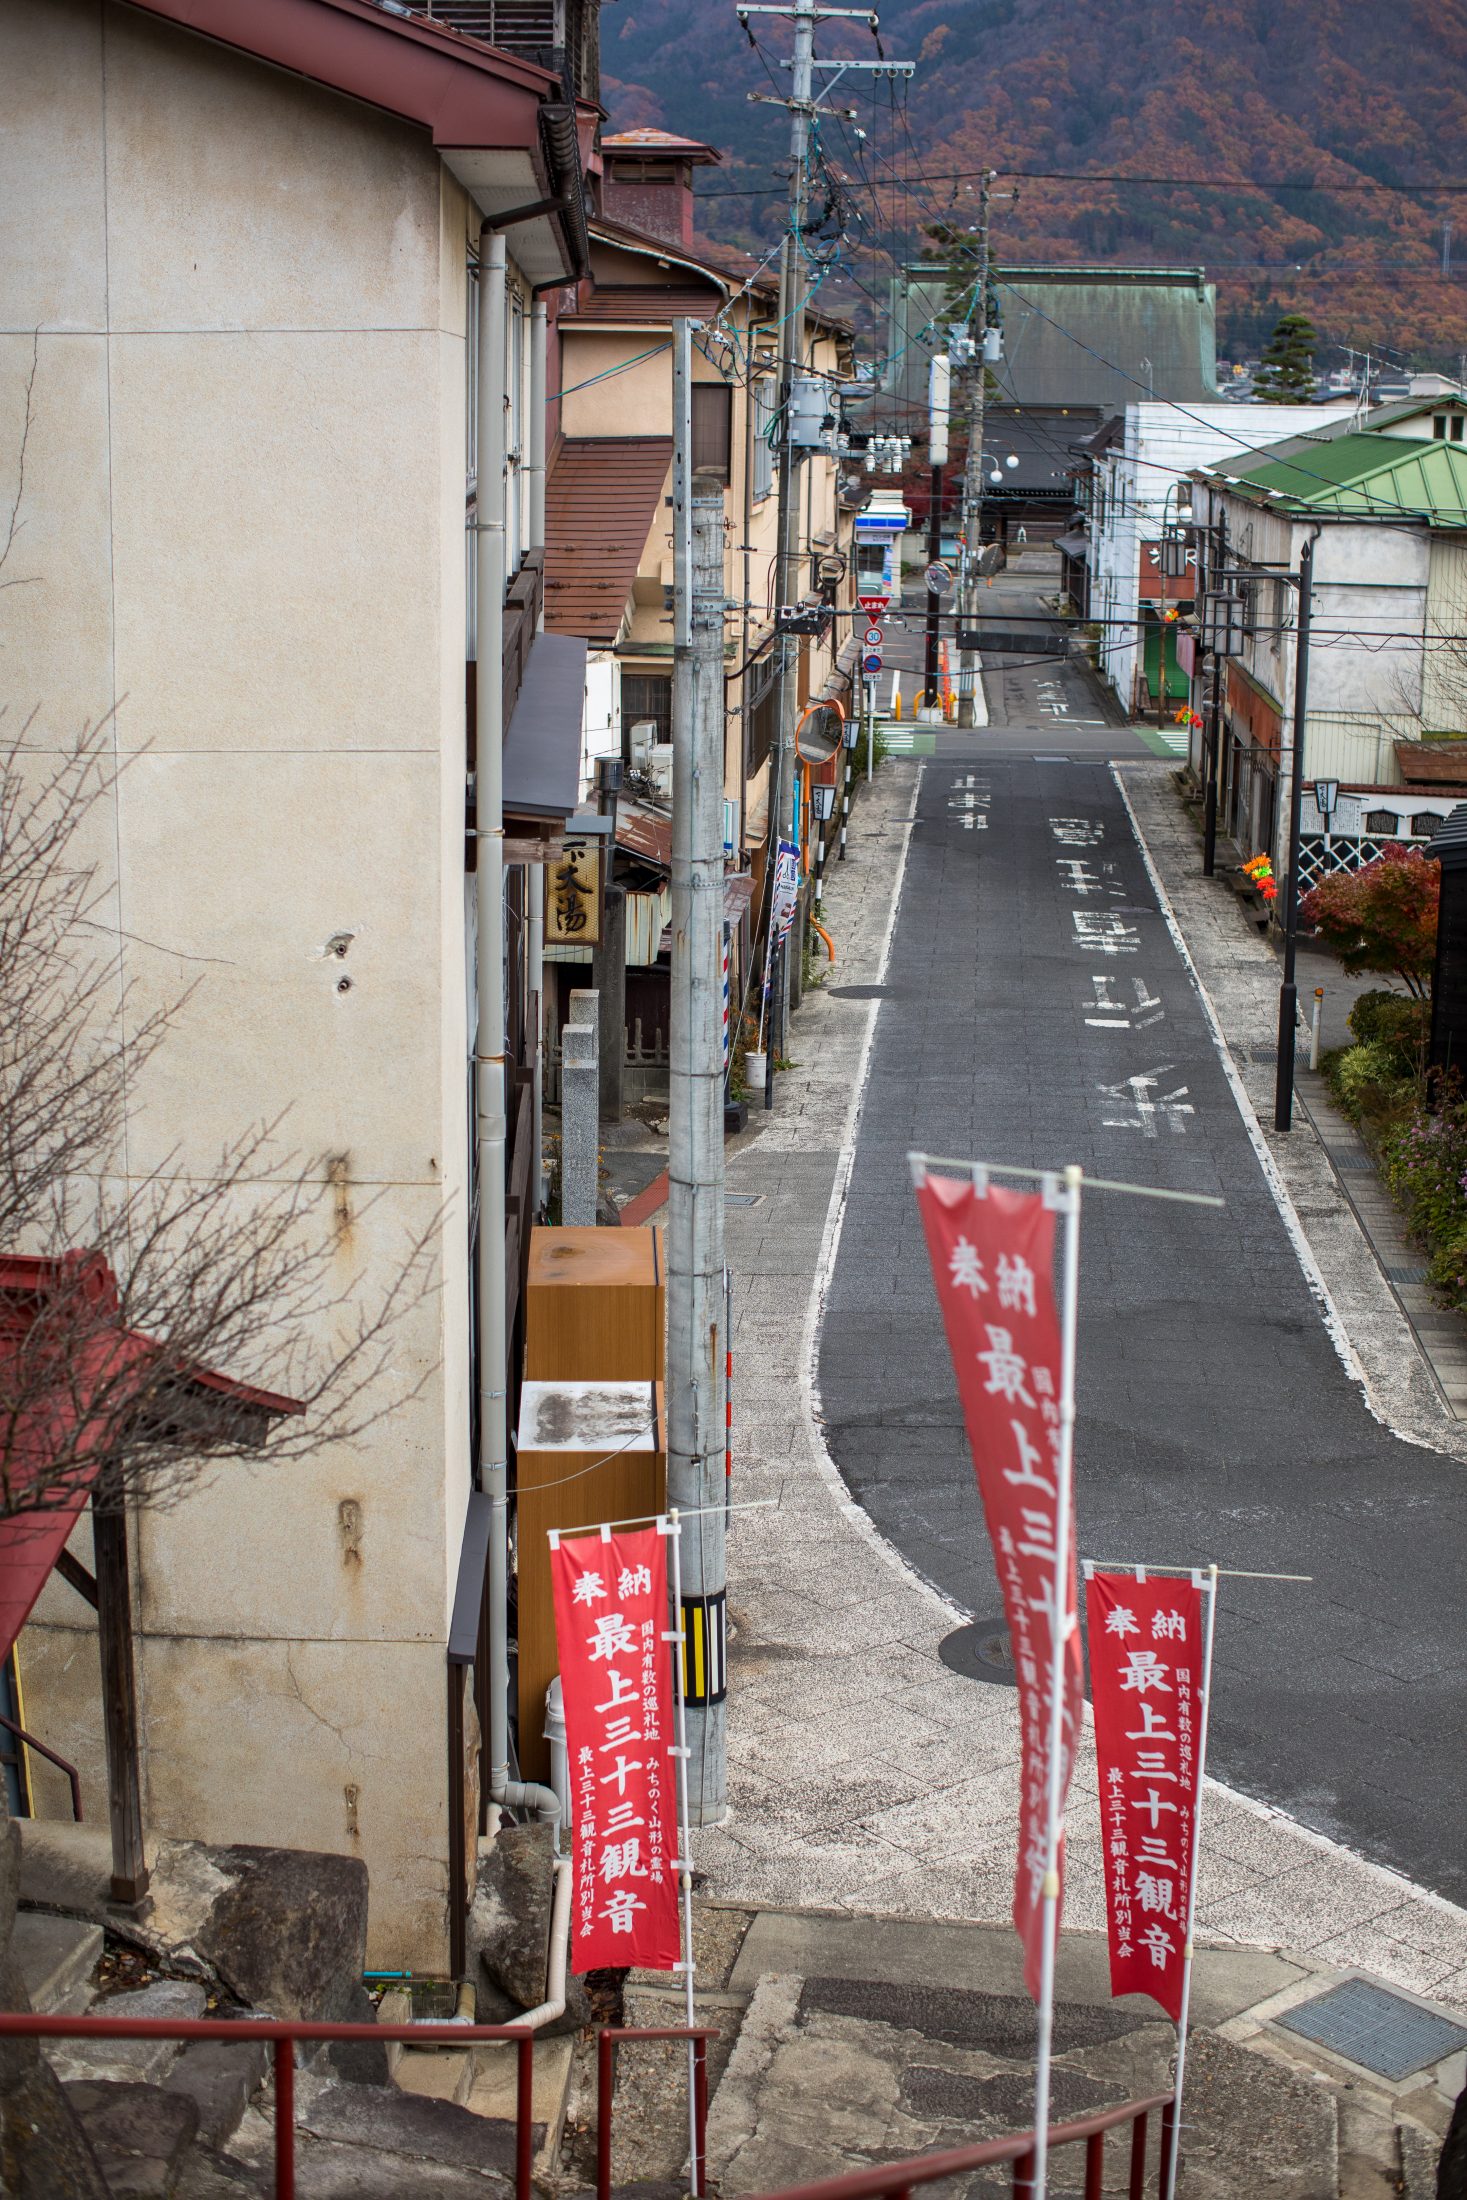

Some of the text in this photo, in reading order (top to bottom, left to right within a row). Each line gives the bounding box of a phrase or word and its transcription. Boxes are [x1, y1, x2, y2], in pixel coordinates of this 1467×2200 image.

[864, 601, 884, 609] 止まれ
[868, 632, 880, 641] 30
[947, 775, 991, 829] 止まれ
[948, 1235, 1037, 1318] 奉納
[571, 1564, 652, 1608] 奉納
[1104, 1604, 1187, 1642] 奉納
[586, 1613, 649, 1934] 最上三十三観音
[1118, 1651, 1179, 1971] 最上三十三観音
[578, 1746, 598, 1938] 最上三十三観音札所別当会
[646, 1757, 664, 1885] みちのく山形の霊場
[1107, 1767, 1135, 1958] 最上三十三観音札所別当会
